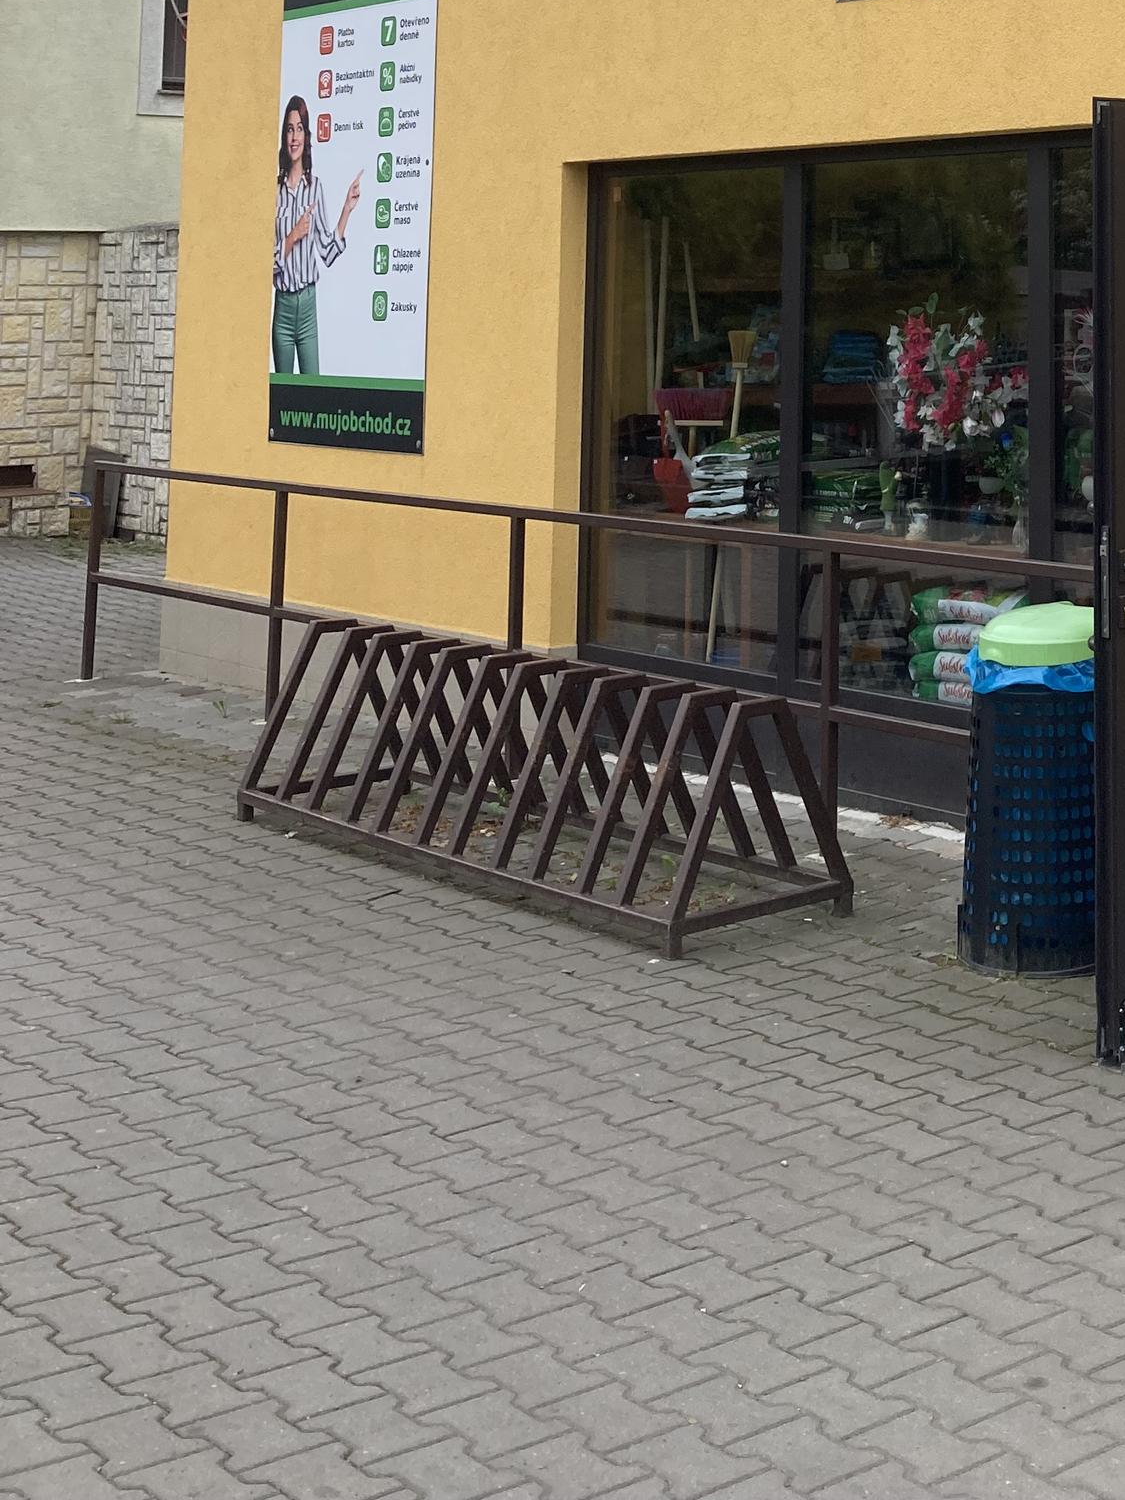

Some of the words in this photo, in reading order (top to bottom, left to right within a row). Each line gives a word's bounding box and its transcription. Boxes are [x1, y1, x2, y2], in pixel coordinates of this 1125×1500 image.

[335, 84, 354, 95] platby
[352, 120, 364, 131] tisk
[396, 169, 421, 179] uzenina
[394, 216, 411, 225] maso
[280, 408, 412, 436] www.mujobchod.cz
